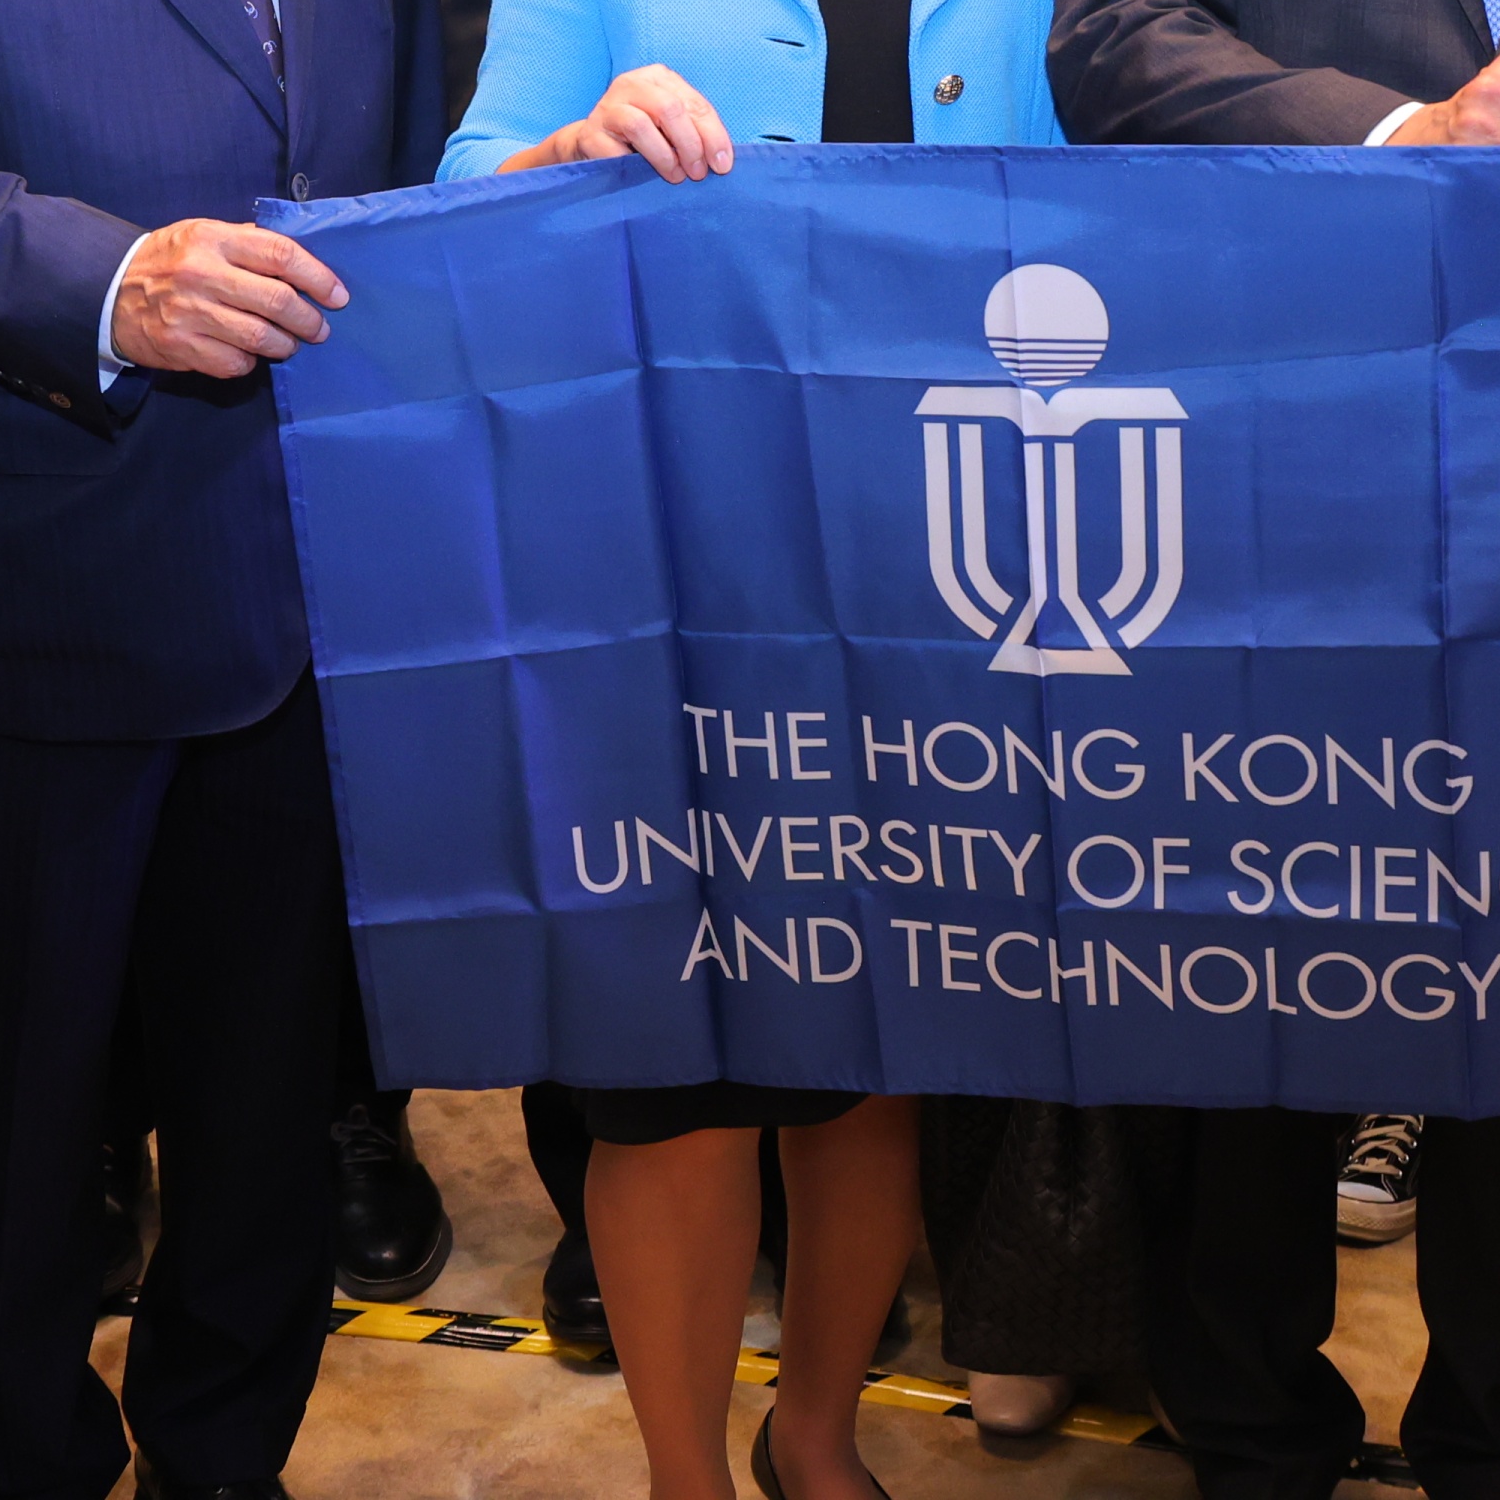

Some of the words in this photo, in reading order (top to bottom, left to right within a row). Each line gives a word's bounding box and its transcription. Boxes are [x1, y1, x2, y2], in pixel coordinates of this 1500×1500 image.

[682, 702, 832, 781] THE
[863, 715, 1147, 802] HONG
[1180, 731, 1475, 816] KONG
[570, 806, 1043, 897] UNIVERSITY
[1065, 834, 1192, 910] OF
[680, 906, 864, 986] AND
